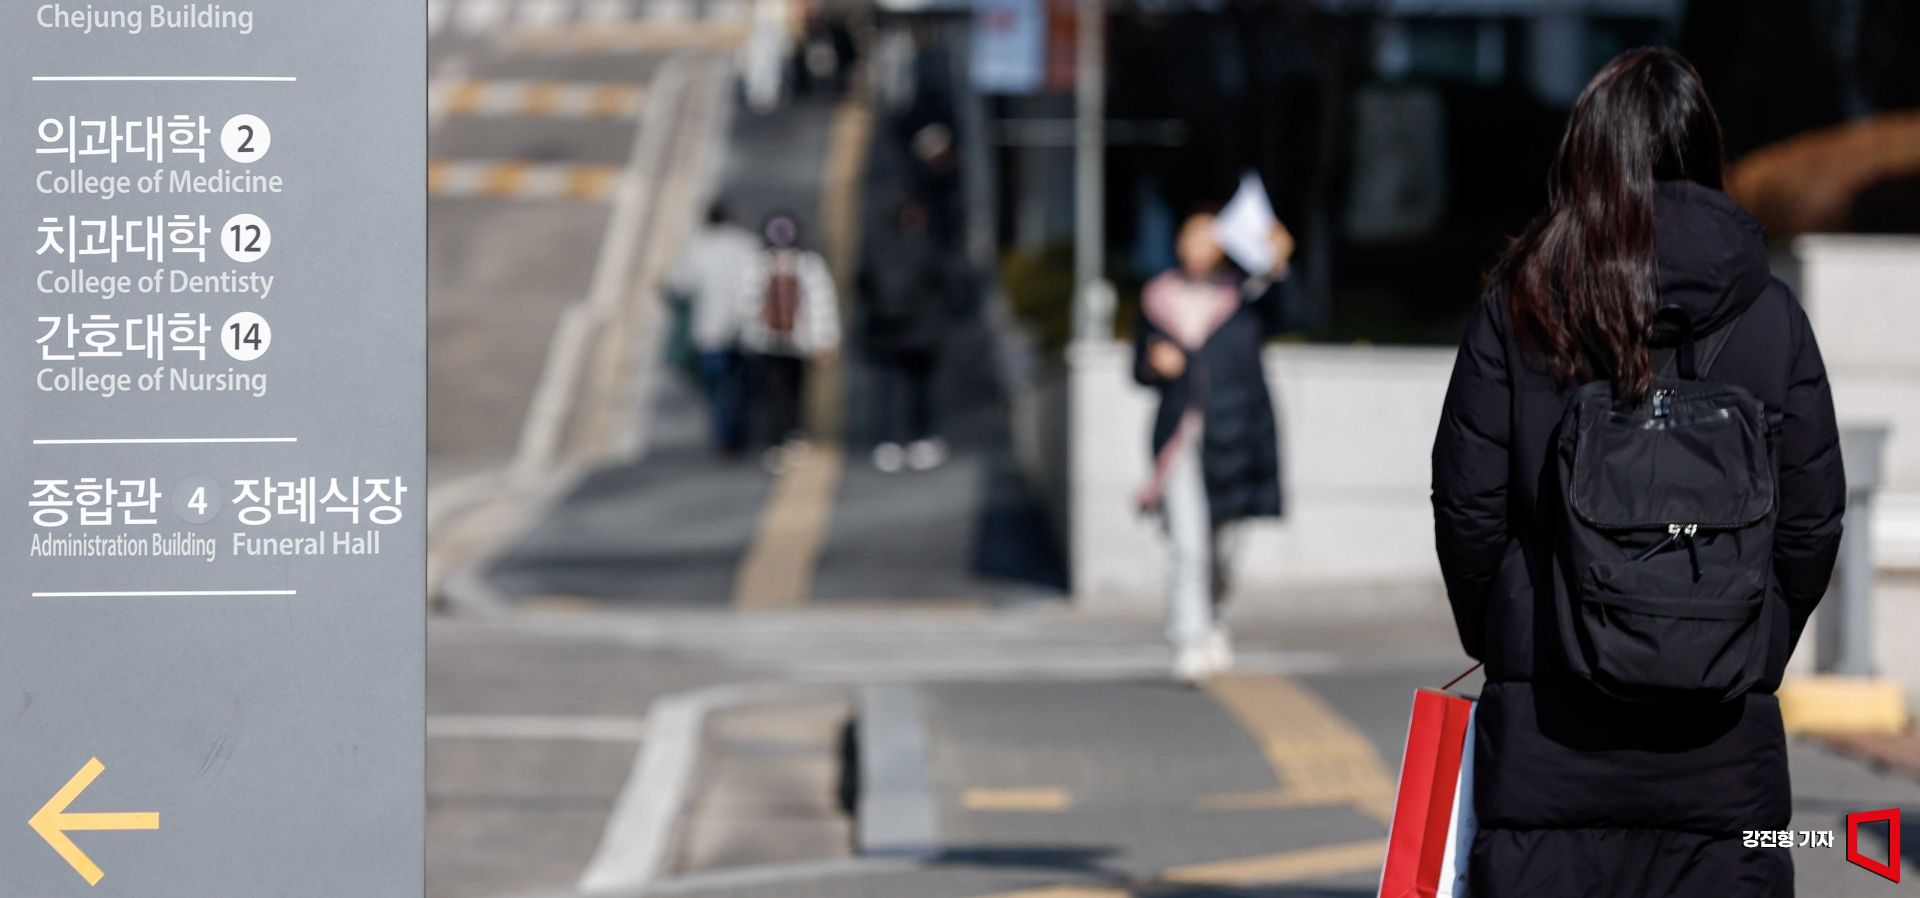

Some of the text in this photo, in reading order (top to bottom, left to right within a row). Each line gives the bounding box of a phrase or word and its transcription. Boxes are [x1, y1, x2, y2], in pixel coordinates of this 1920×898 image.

[37, 4, 253, 34] Chejung Building
[36, 115, 255, 163] 의과대학 2
[36, 169, 283, 199] College of Medicine
[36, 215, 262, 263] 치과대학 12
[36, 269, 274, 299] College of Dentisty
[36, 313, 262, 361] 간호대학 14
[36, 367, 267, 397] College of Nursing
[28, 476, 408, 527] 종합관 4 장례식장
[30, 530, 380, 562] Administration Building Funeral Hall
